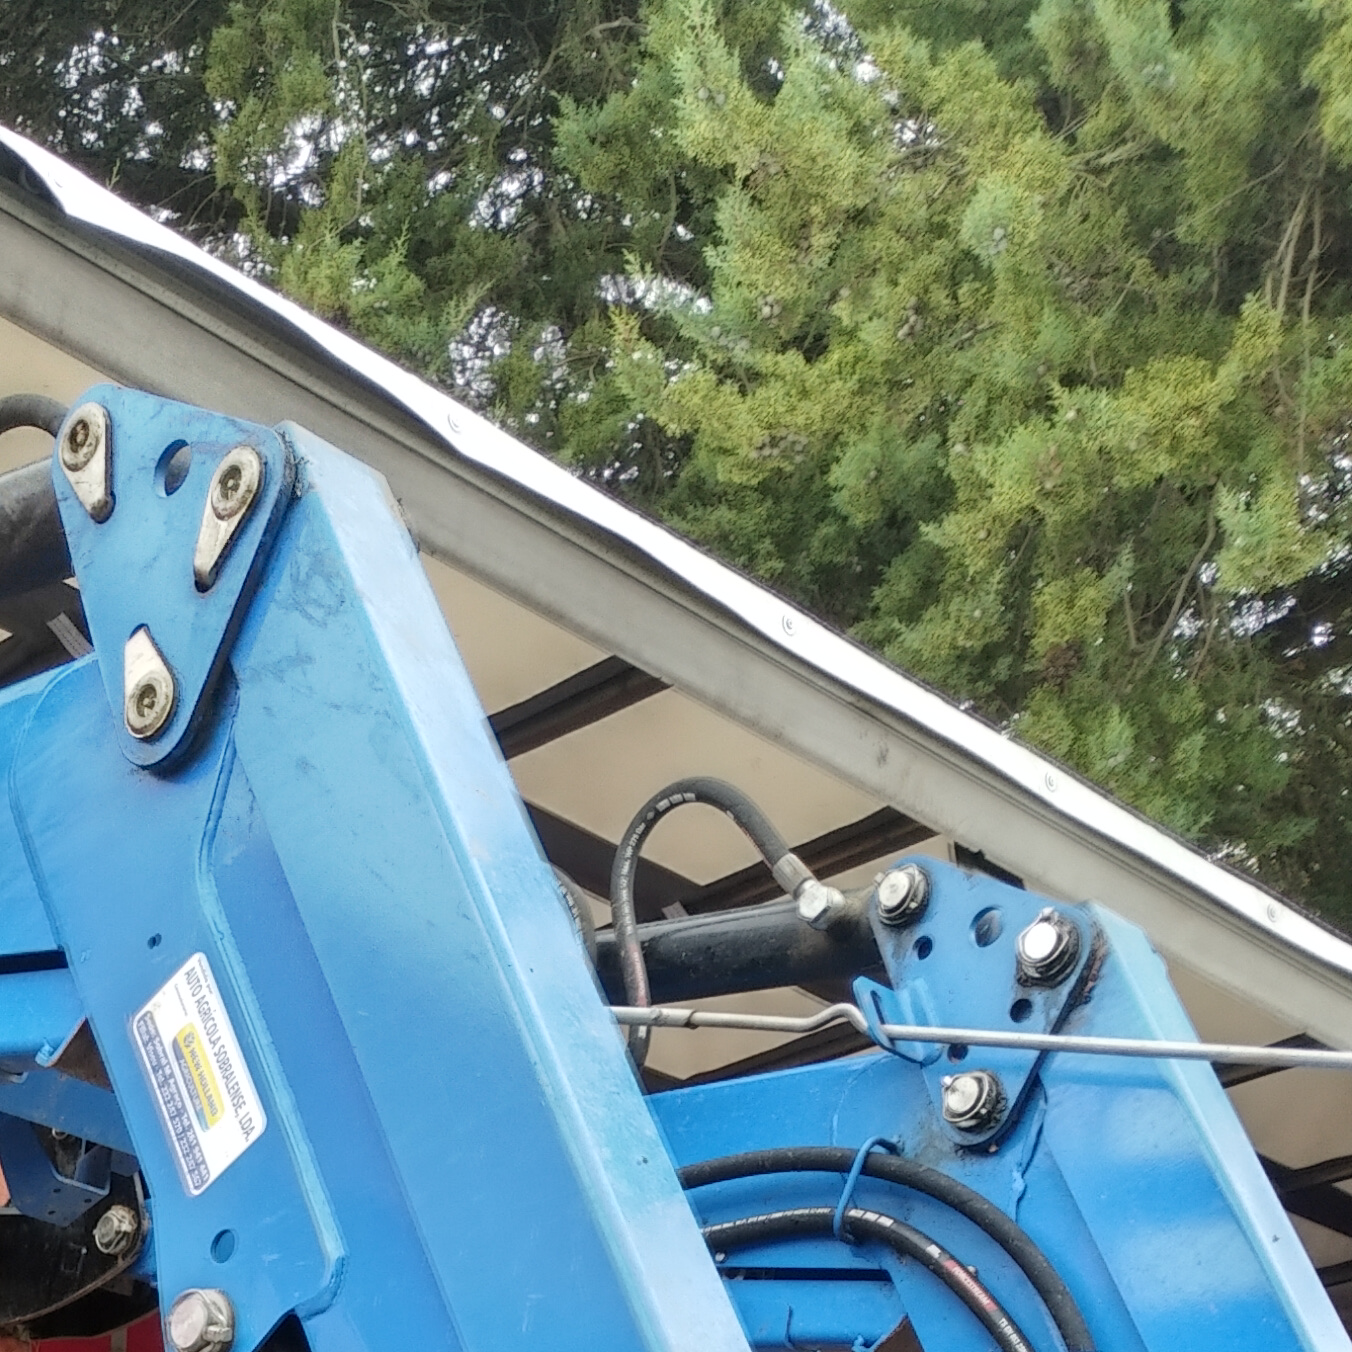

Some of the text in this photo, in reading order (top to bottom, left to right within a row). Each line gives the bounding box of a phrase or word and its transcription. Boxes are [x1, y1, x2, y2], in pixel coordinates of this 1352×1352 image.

[178, 1058, 202, 1111] AGRICULTURE
[184, 965, 256, 1142] AUTO AGRÍCOLA SOBRALENSE, LDA.
[188, 1046, 218, 1116] NEW HOLLAND
